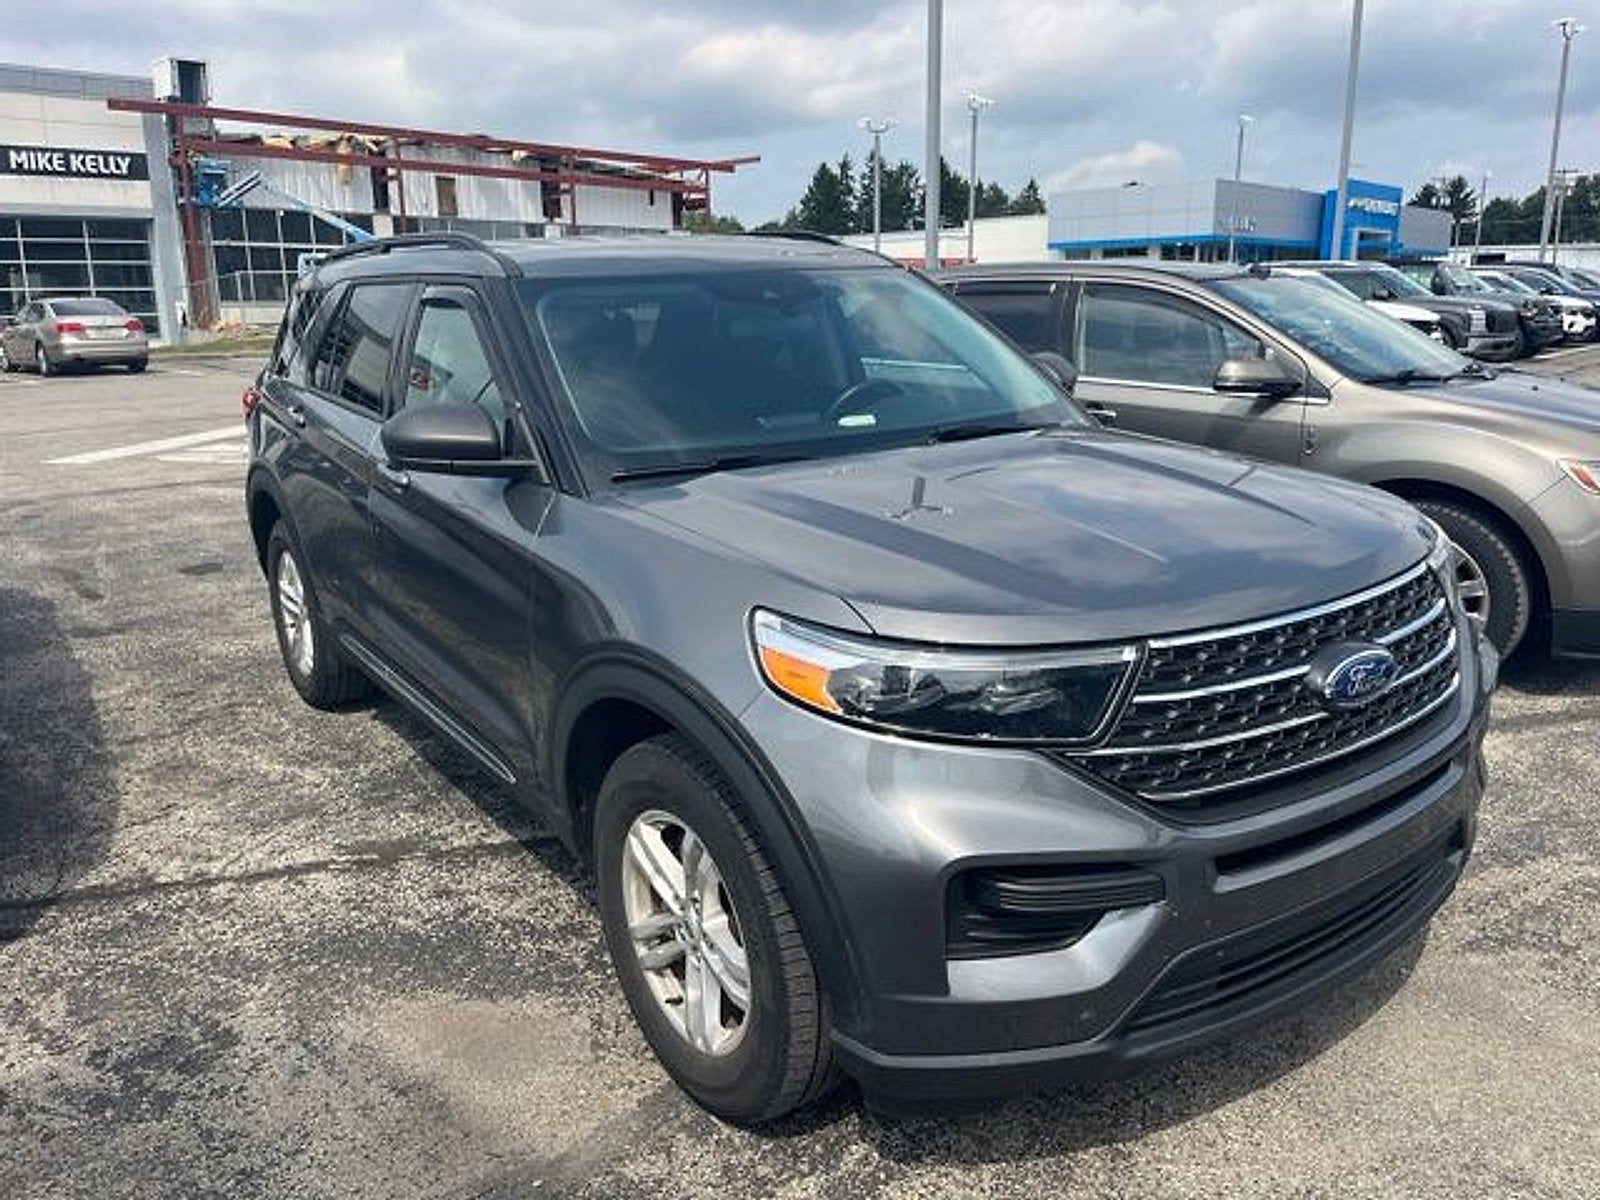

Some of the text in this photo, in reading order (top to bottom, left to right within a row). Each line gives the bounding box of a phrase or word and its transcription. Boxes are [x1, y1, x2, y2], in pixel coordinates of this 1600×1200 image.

[9, 149, 131, 175] MIKE KELLY
[1346, 661, 1388, 697] Ford
